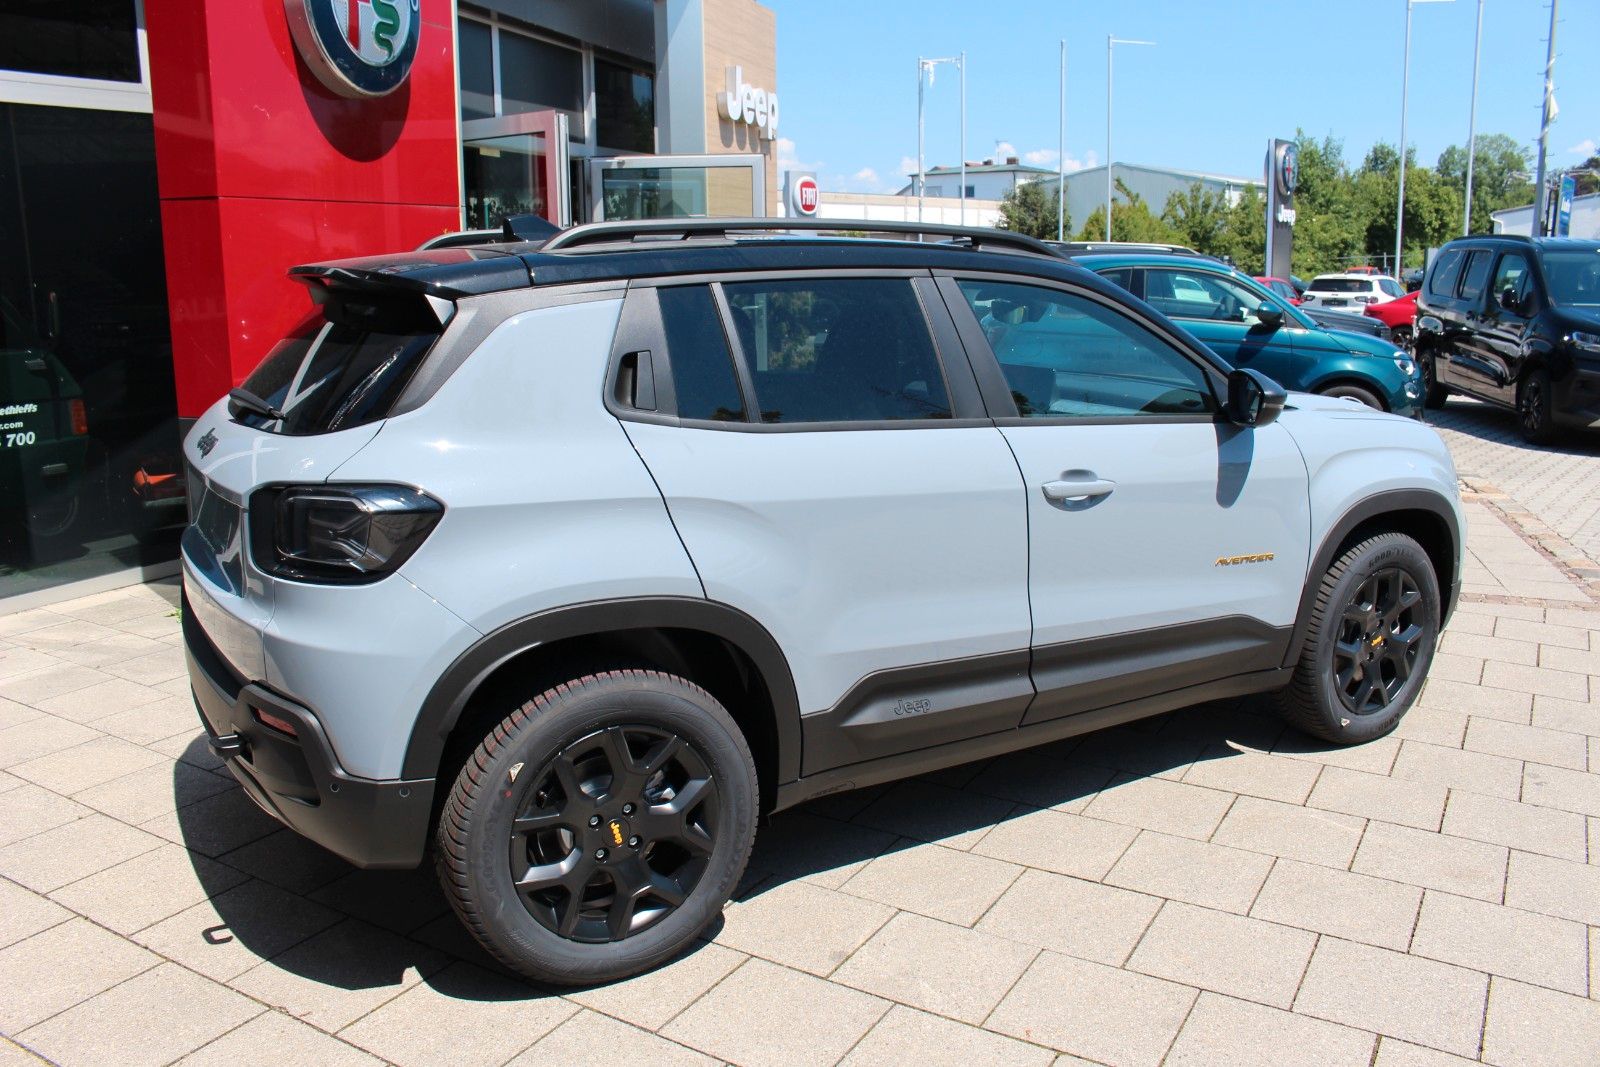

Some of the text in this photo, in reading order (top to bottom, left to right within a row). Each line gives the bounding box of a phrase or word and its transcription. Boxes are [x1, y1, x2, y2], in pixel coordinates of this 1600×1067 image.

[717, 65, 778, 140] Jeep
[801, 187, 816, 205] FIAT
[1278, 204, 1296, 226] Jeep
[0, 404, 38, 416] ethleffs
[0, 421, 23, 430] r.com
[6, 431, 36, 447] 700
[1215, 552, 1274, 566] AVENGER
[894, 698, 931, 715] Jeep
[610, 822, 623, 845] Jeep
